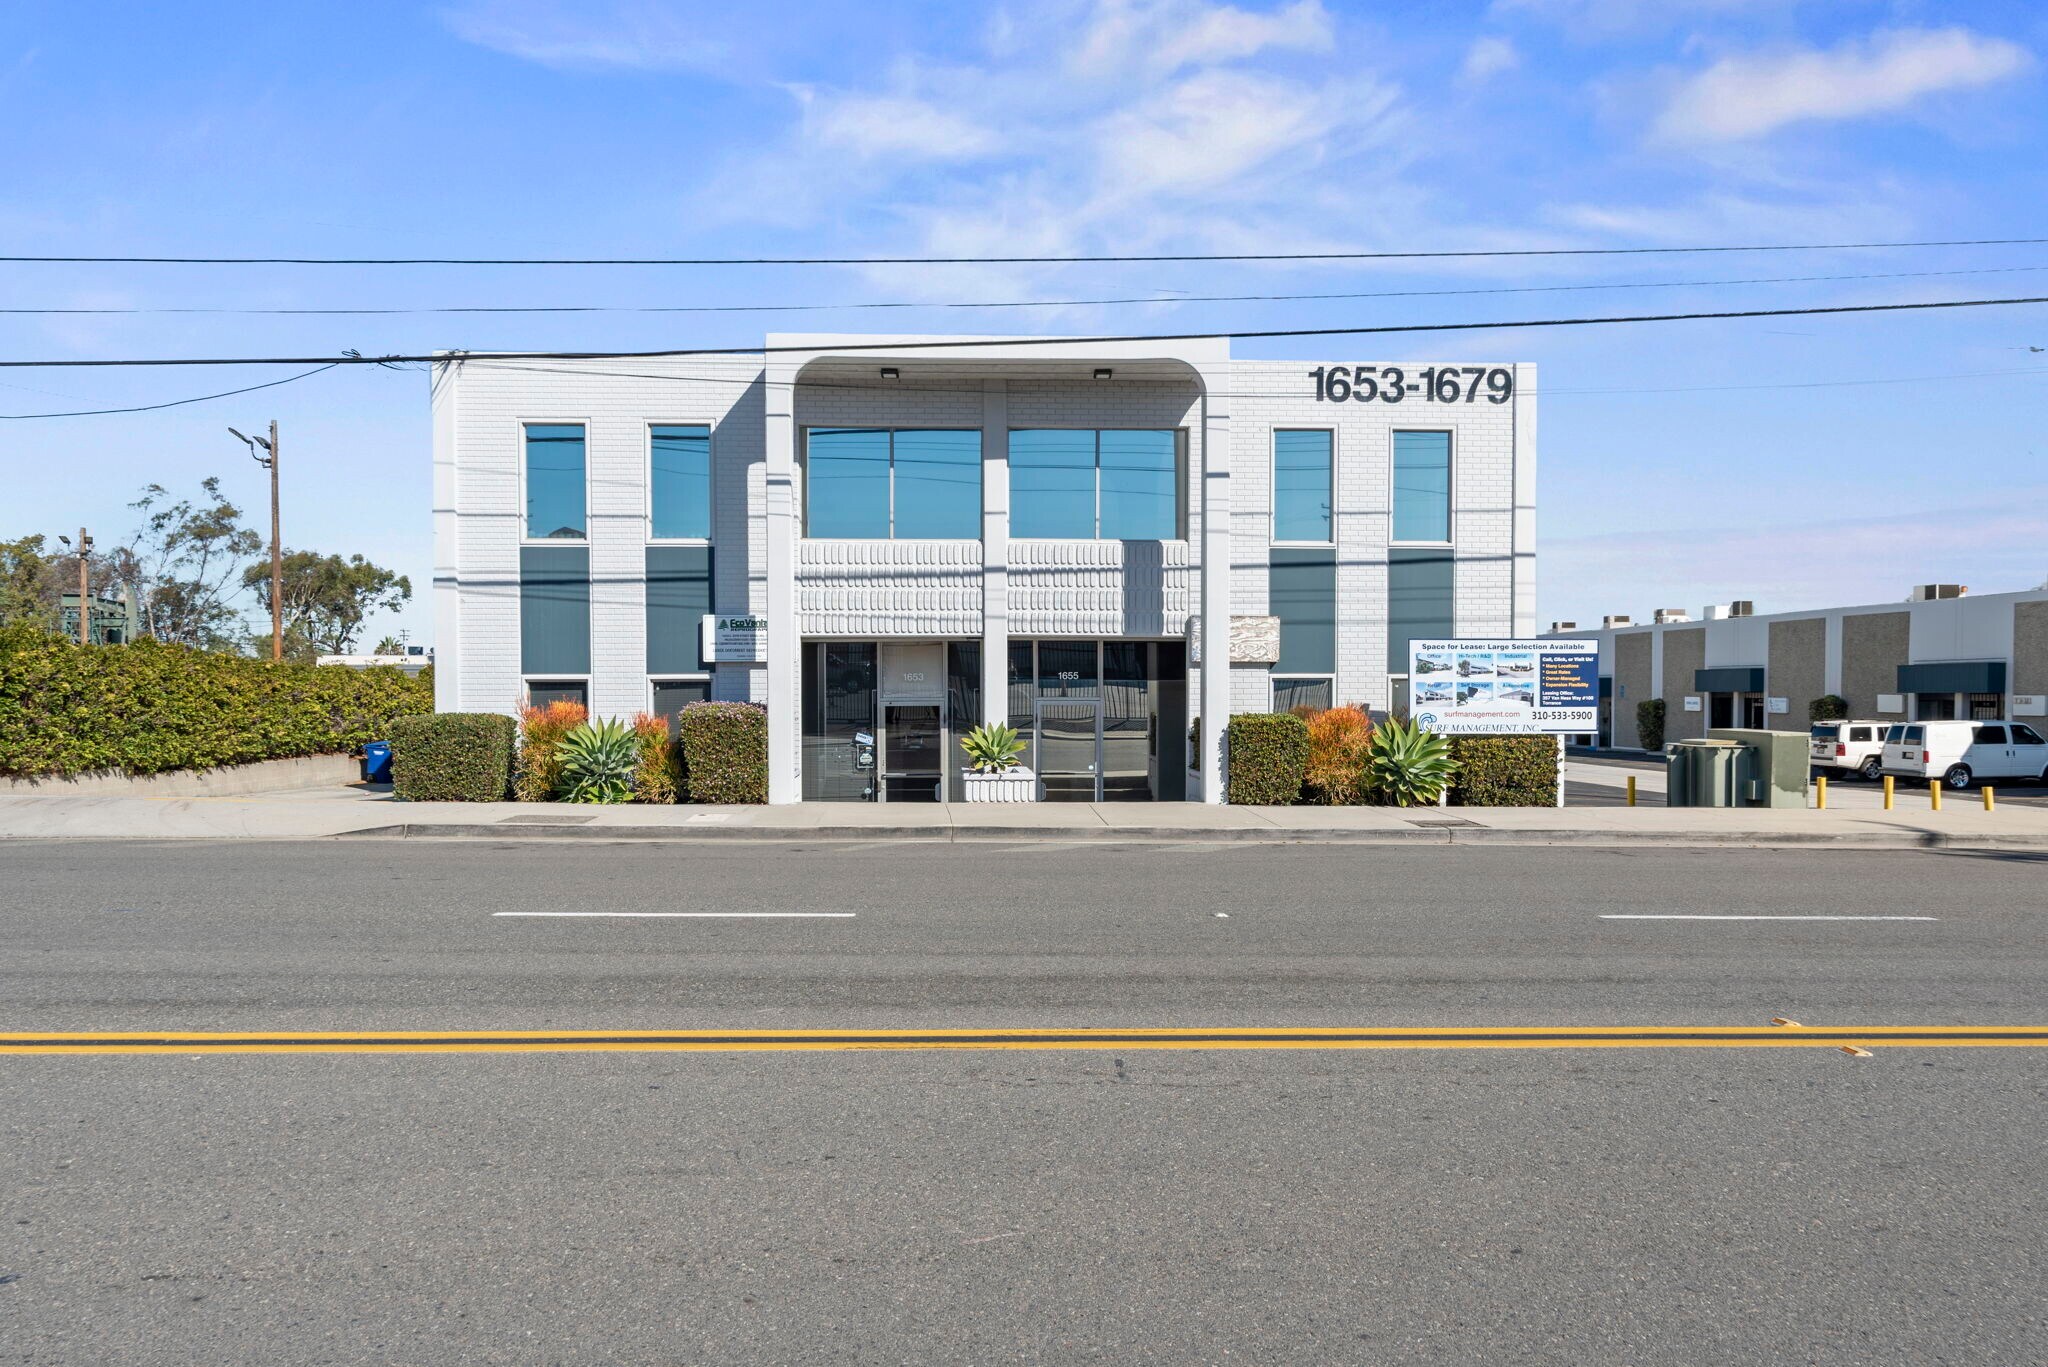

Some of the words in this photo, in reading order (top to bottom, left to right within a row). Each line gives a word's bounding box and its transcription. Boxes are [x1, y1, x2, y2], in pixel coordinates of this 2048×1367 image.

[1308, 366, 1513, 405] 1653-1679
[903, 673, 924, 681] 1653
[1058, 671, 1079, 680] 1655
[1532, 711, 1593, 720] 310-533-5900
